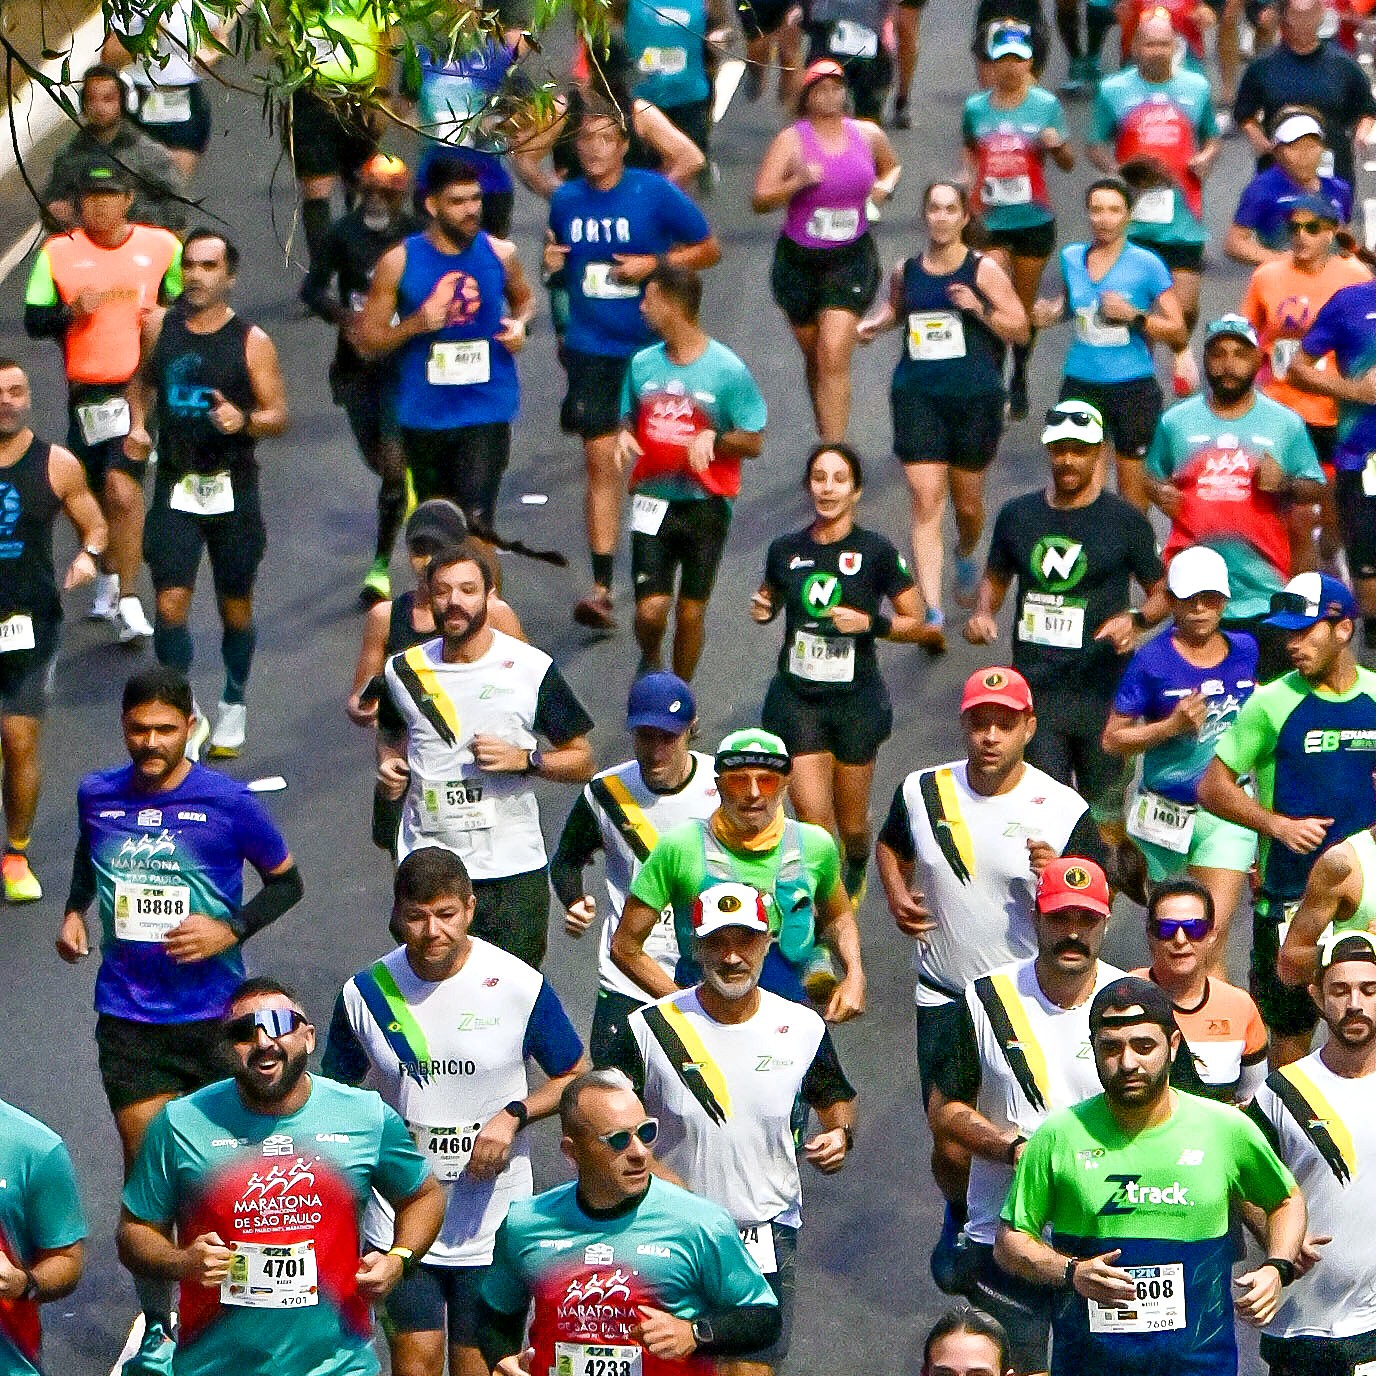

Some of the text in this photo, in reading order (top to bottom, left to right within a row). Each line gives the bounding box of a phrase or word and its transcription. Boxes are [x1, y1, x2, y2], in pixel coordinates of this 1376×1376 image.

[398, 1061, 475, 1076] FABRICIO
[427, 1137, 470, 1155] 4460
[234, 1193, 323, 1214] MARATONA
[235, 1212, 323, 1229] DE SÃO PAULO
[262, 1260, 305, 1280] 4701
[280, 1297, 306, 1308] 4701
[557, 1303, 637, 1321] MARATONA
